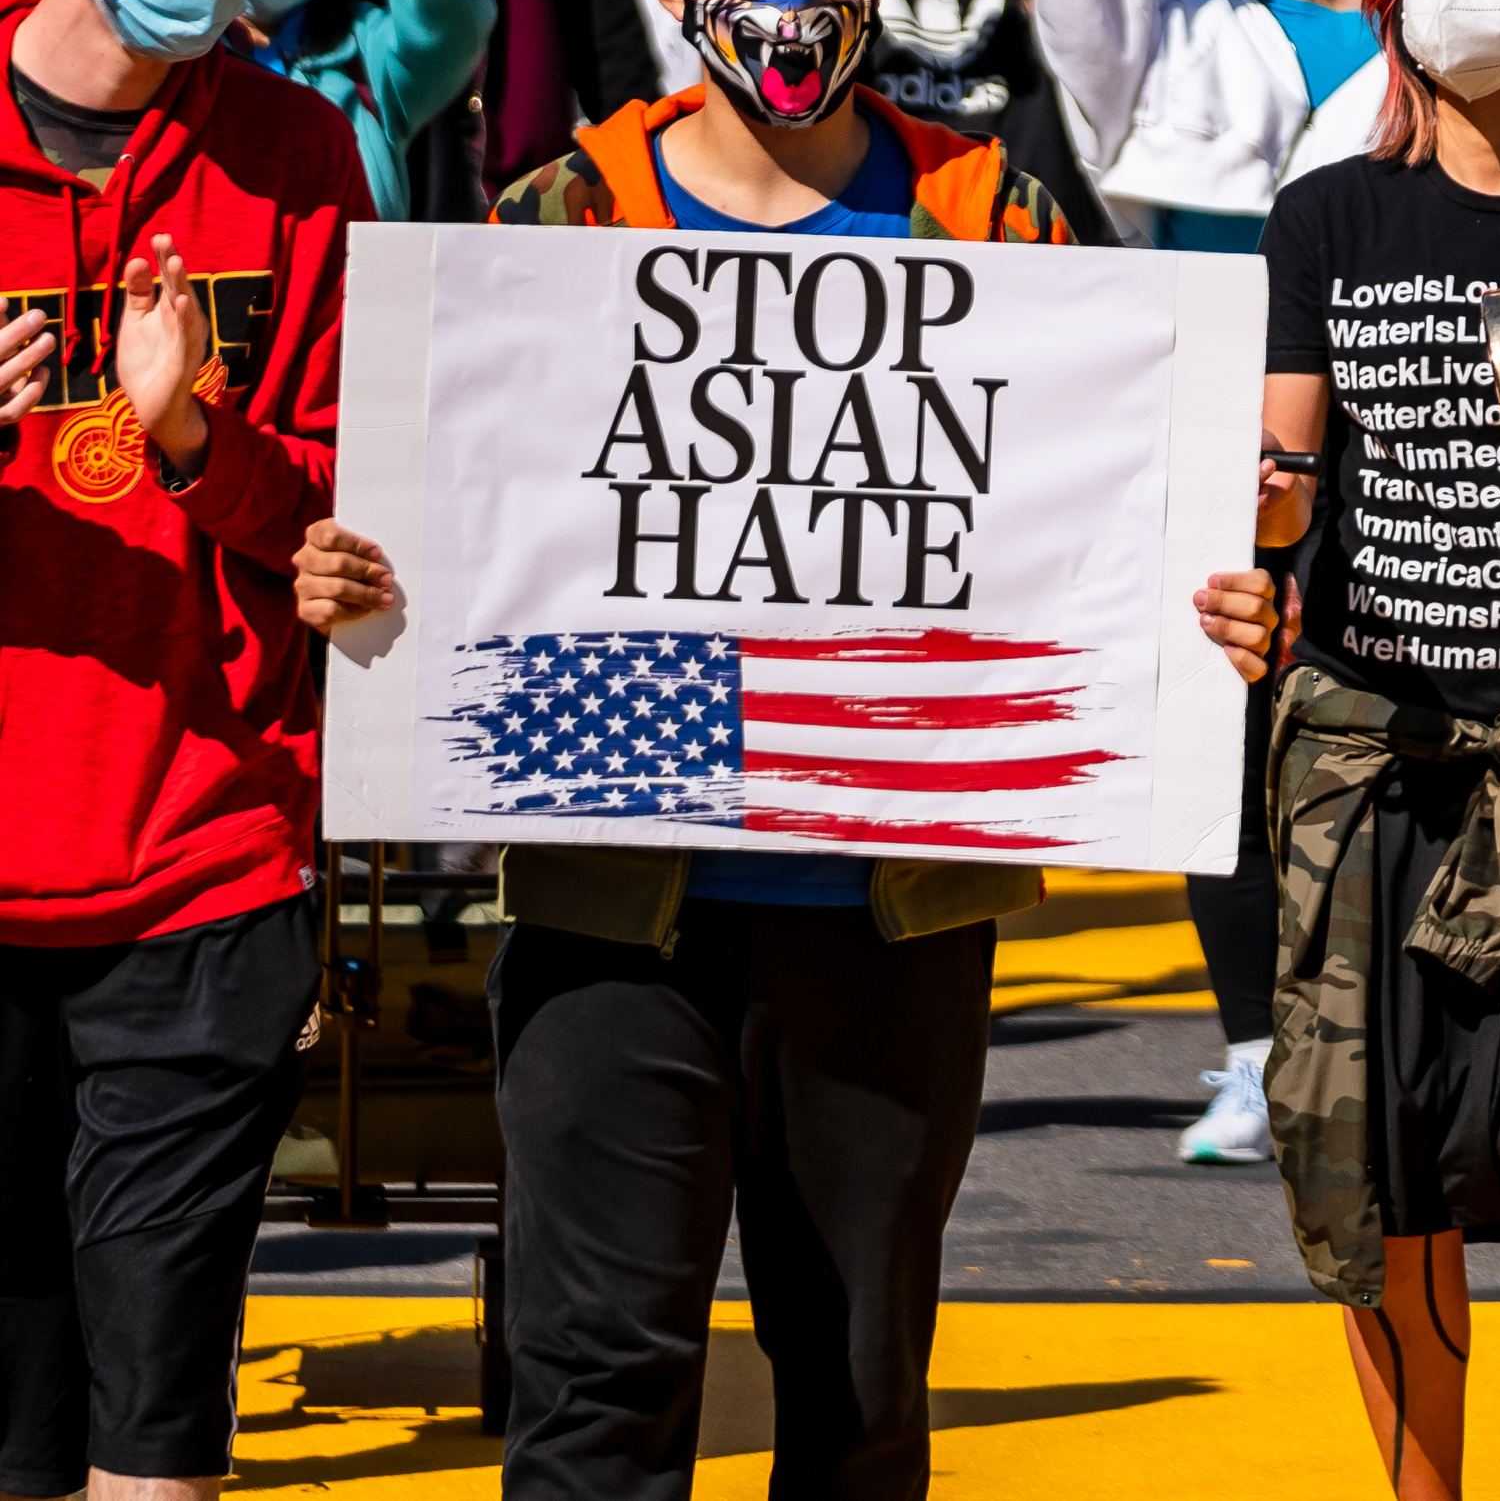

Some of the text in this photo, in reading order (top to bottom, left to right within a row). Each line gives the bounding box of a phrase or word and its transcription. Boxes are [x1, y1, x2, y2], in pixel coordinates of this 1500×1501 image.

[633, 245, 975, 373] STOP
[1327, 315, 1486, 348] WaterIsLi
[1332, 356, 1494, 390] BlackLive
[581, 363, 1009, 495] ASIAN
[602, 481, 974, 610] HATE
